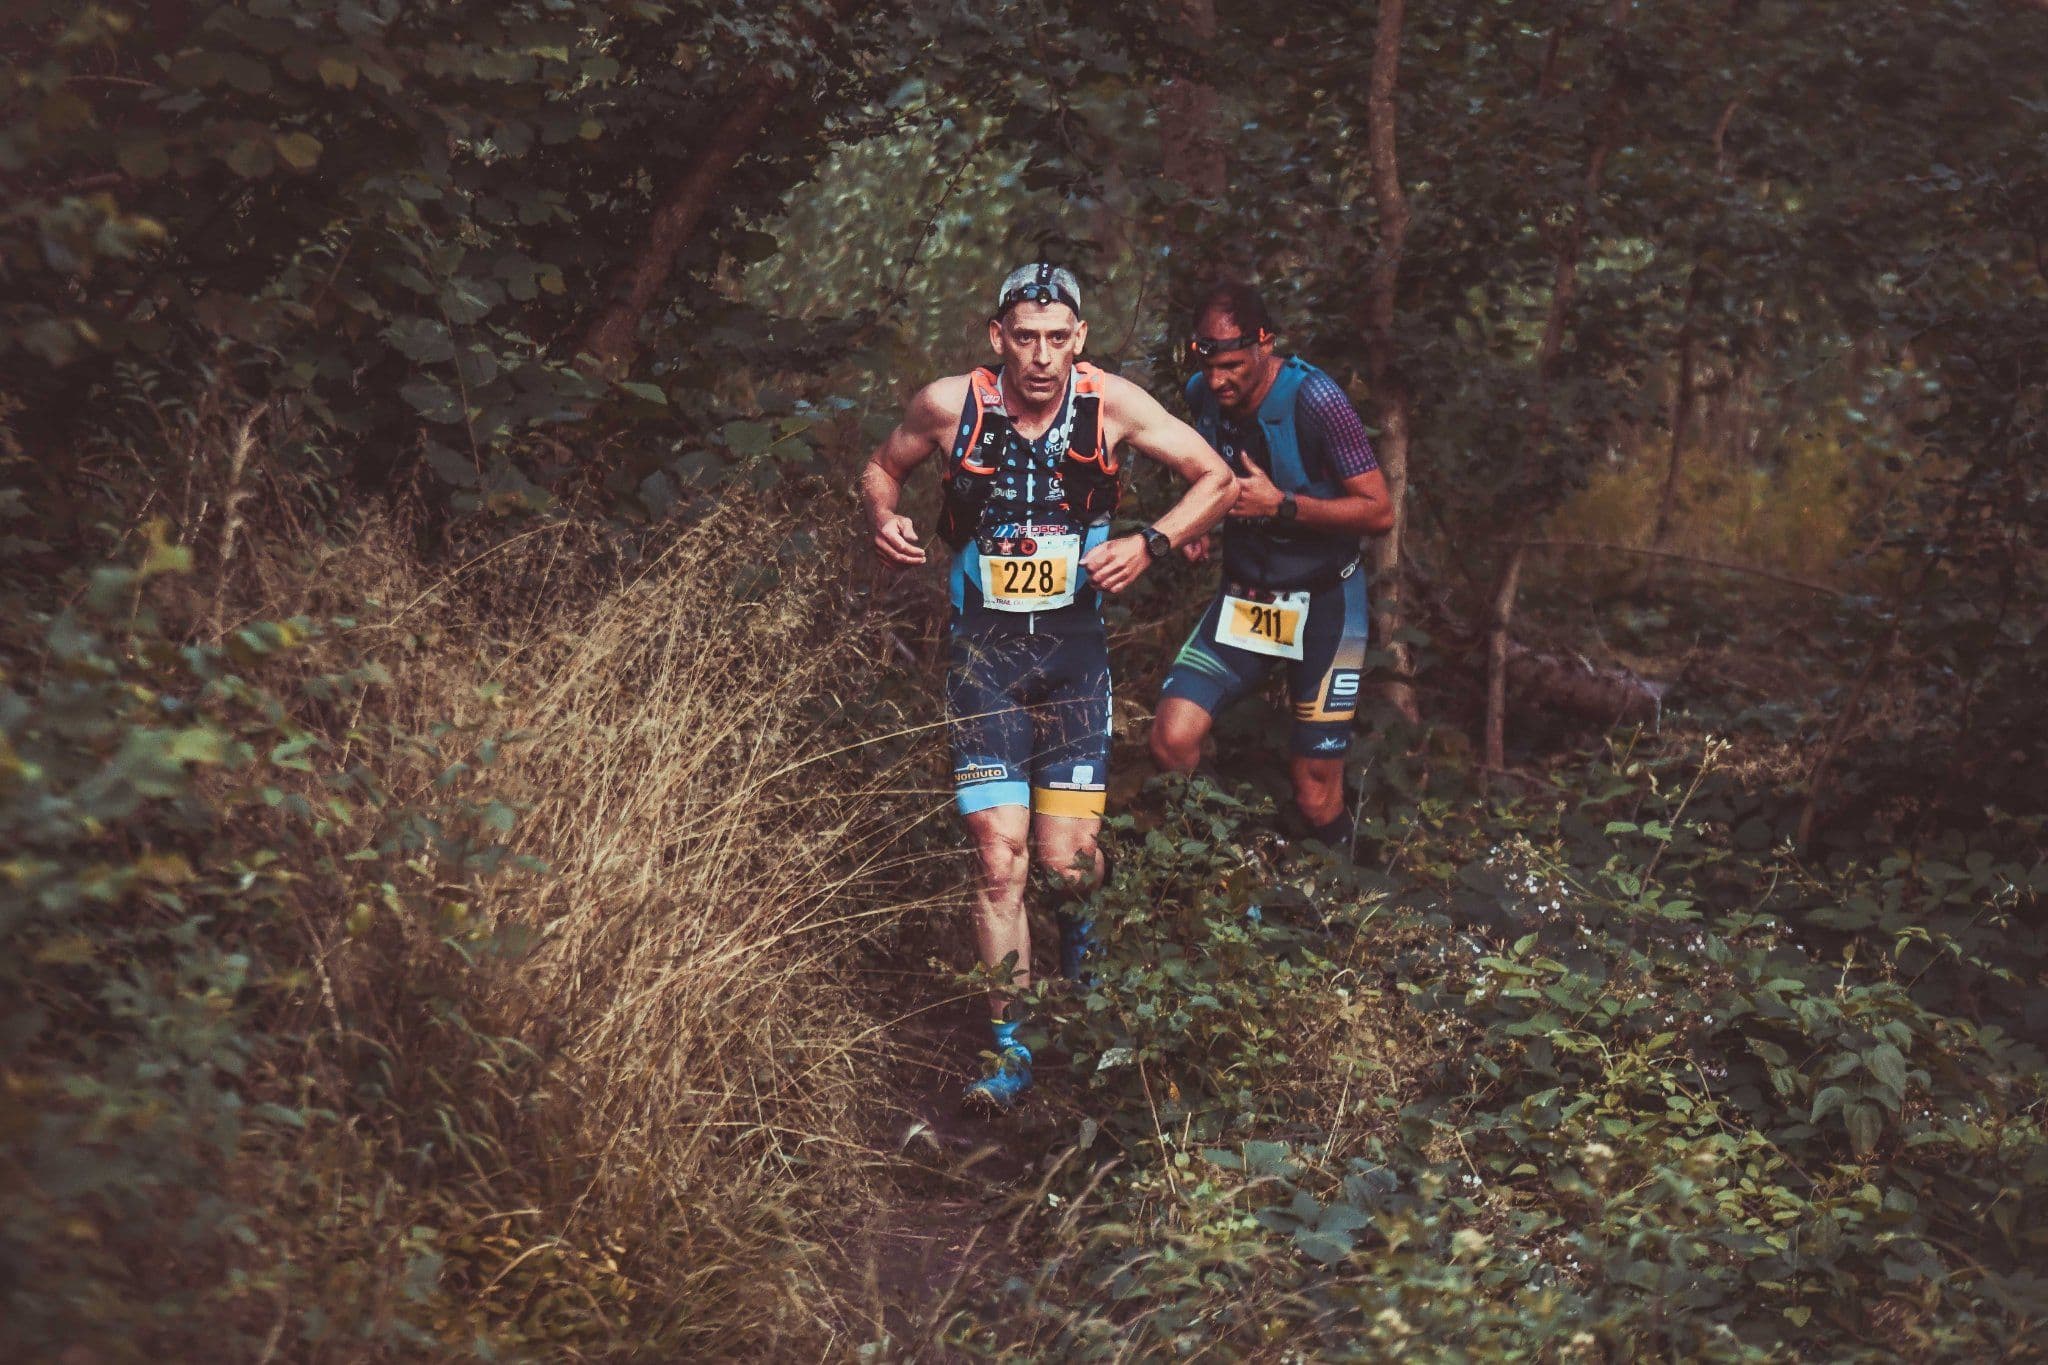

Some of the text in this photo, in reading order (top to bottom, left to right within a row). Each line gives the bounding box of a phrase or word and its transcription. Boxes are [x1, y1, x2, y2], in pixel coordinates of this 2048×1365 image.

[1004, 560, 1054, 594] 228
[1250, 606, 1281, 641] 211
[1333, 673, 1360, 695] S
